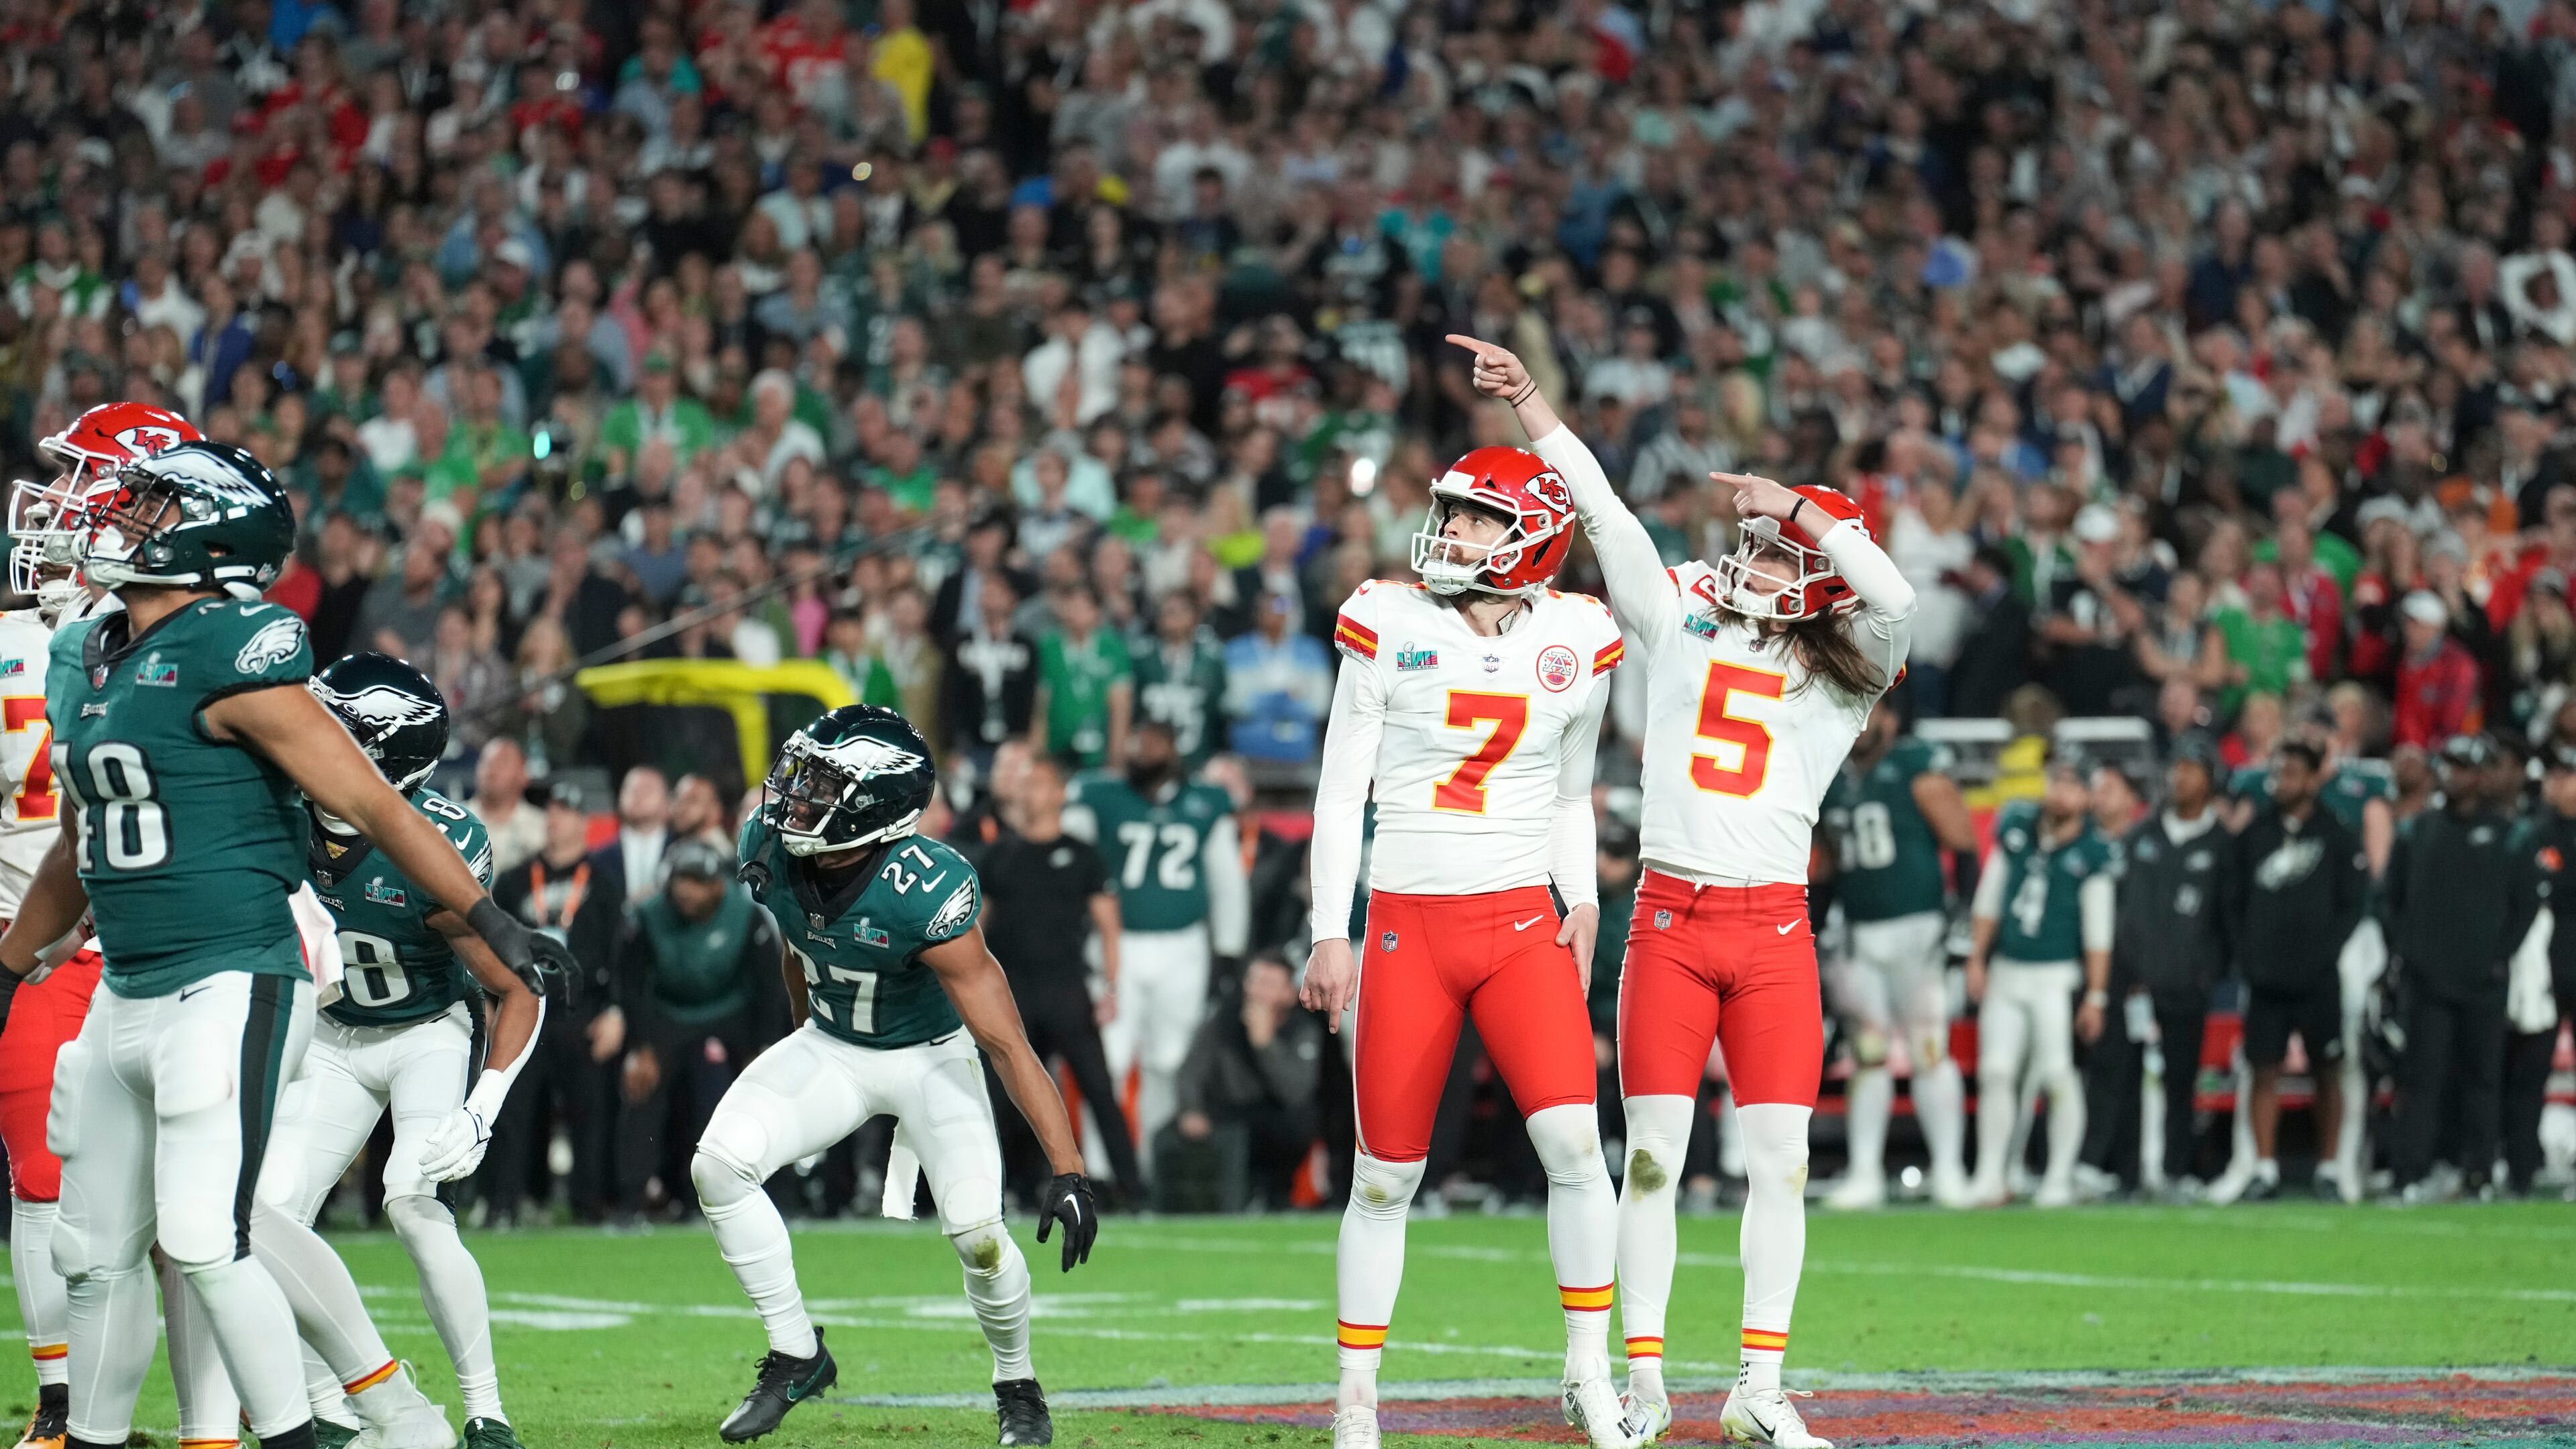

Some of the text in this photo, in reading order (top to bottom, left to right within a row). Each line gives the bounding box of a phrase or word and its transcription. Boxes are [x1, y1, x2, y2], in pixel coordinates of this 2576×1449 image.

[132, 429, 172, 456] K
[1537, 477, 1567, 505] KC
[1431, 689, 1529, 814] 7
[1689, 659, 1787, 800] 5
[881, 844, 936, 896] 27
[1116, 821, 1199, 891] 72
[1384, 941, 1395, 949] NFL
